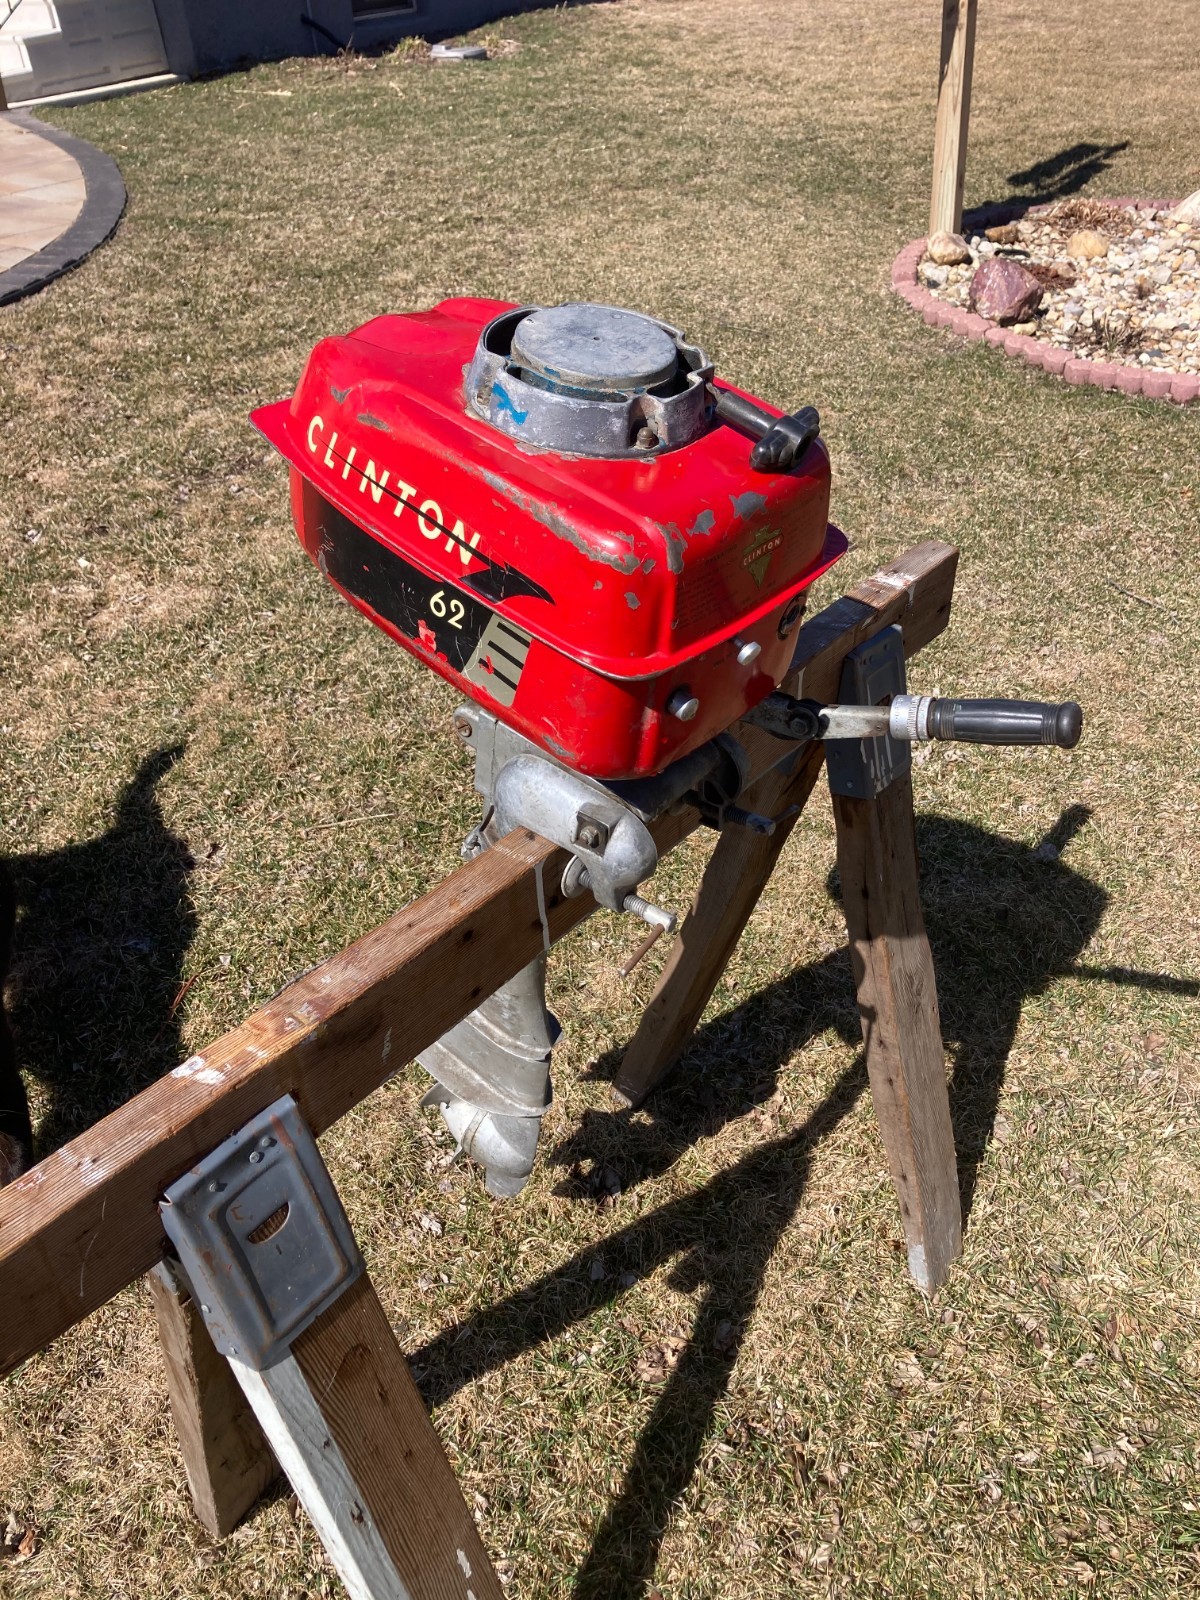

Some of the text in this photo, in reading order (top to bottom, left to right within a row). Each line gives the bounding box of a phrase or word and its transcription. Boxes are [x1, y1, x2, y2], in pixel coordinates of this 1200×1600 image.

[307, 415, 481, 565] CLINTON
[743, 537, 781, 566] CLINTON
[429, 590, 466, 629] 62
